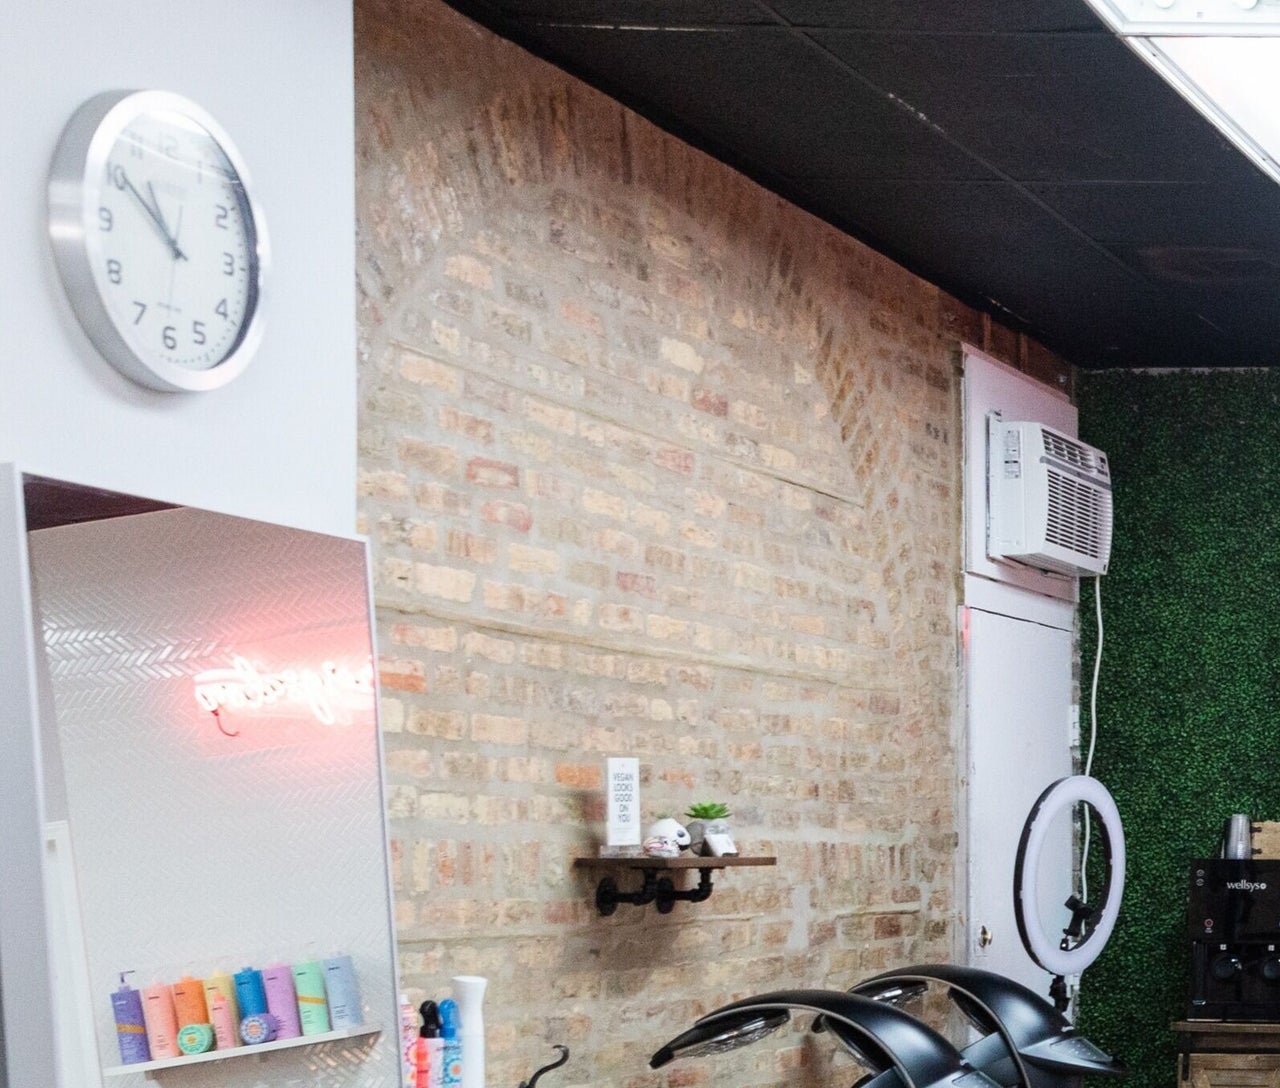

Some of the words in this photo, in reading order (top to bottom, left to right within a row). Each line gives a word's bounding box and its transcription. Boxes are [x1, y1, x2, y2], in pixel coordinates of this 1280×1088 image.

[106, 161, 125, 190] 10
[99, 207, 113, 232] 9
[216, 204, 229, 229] 2
[106, 259, 121, 285] 8
[223, 252, 235, 277] 3
[133, 301, 147, 325] 7
[215, 298, 229, 321] 4
[162, 325, 177, 350] 6
[193, 321, 206, 345] 5
[613, 773, 633, 781] VEGAN
[613, 783, 633, 792] LOOKS
[615, 794, 632, 802] GOOD
[618, 814, 630, 823] YOU
[1227, 880, 1260, 892] wellsys
